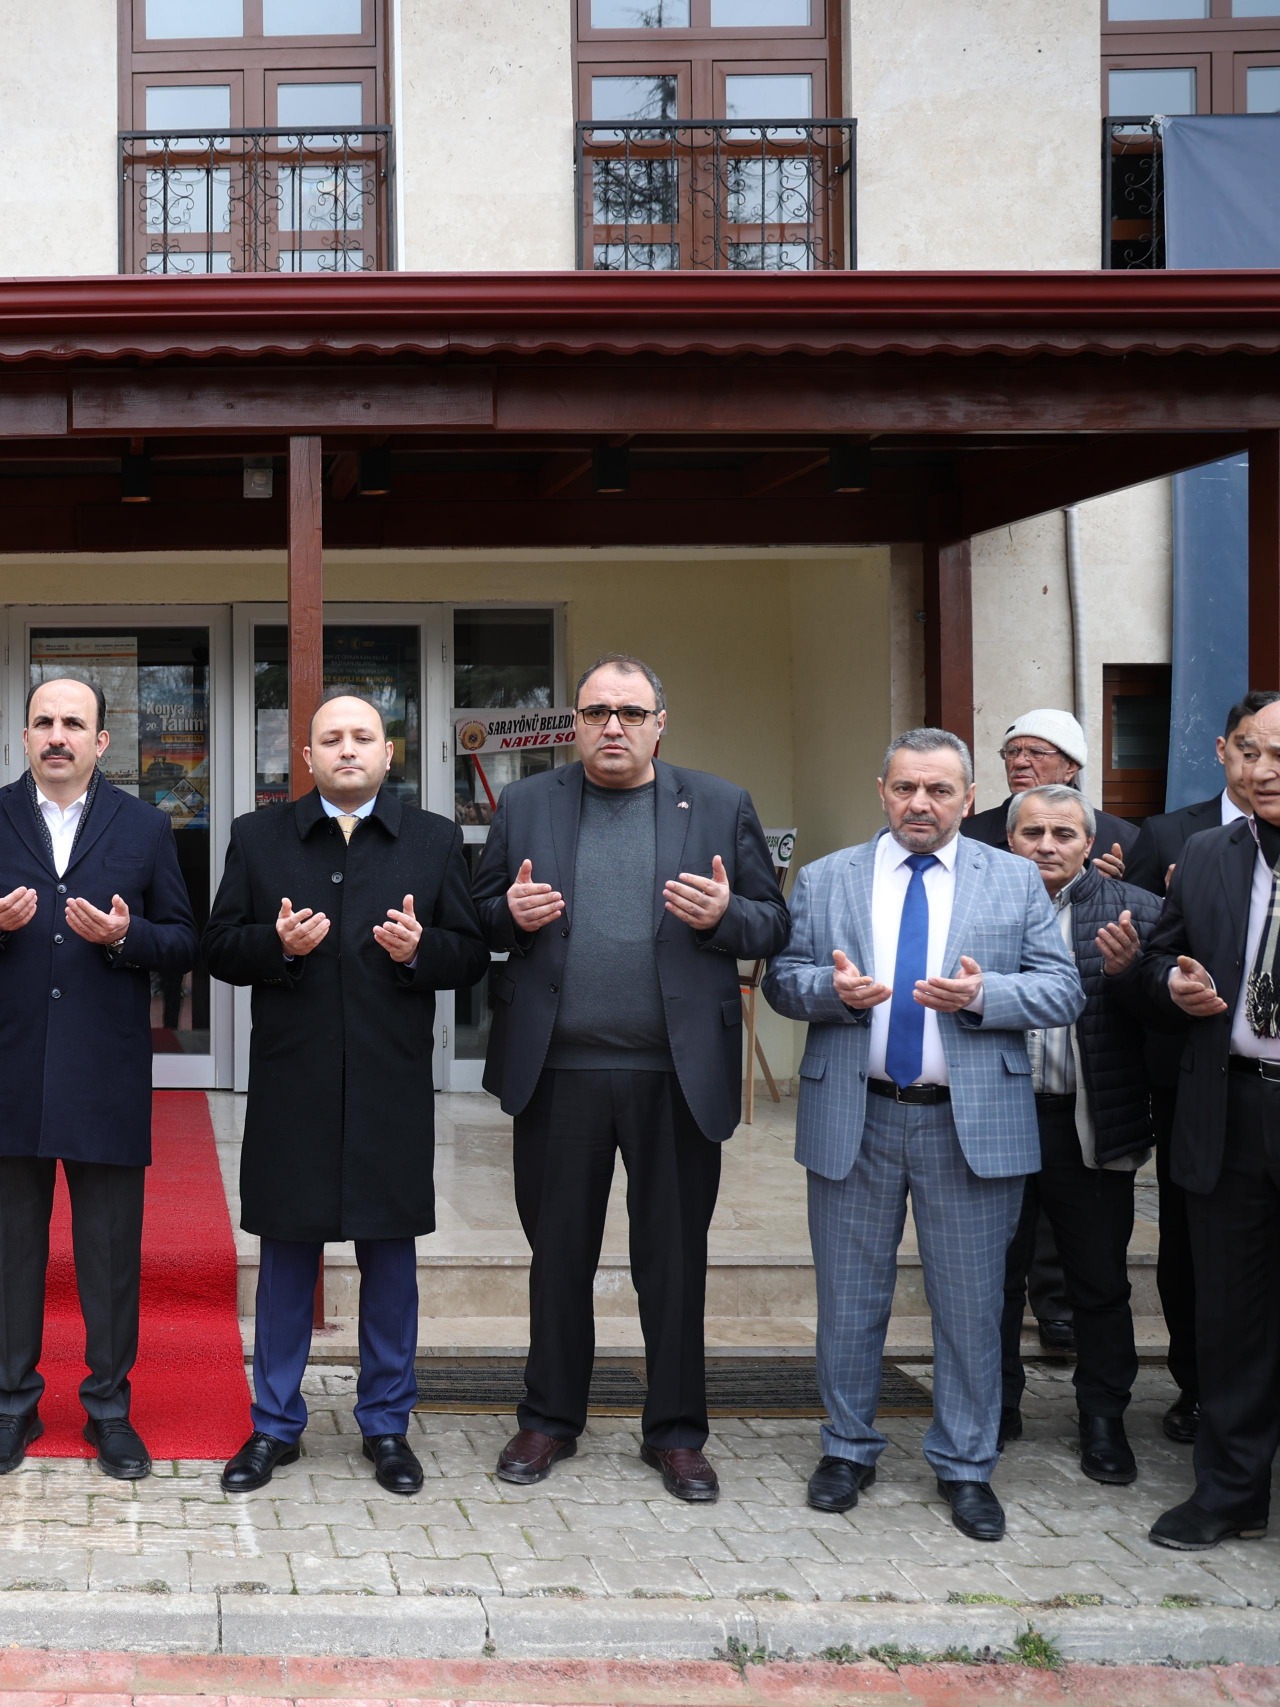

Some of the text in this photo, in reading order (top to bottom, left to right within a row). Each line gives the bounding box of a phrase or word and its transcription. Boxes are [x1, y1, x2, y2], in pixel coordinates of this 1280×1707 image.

[146, 701, 185, 716] Konya
[159, 715, 204, 731] Tarım
[488, 714, 539, 735] SARAYÖNÜ
[500, 732, 551, 749] NAFİZ
